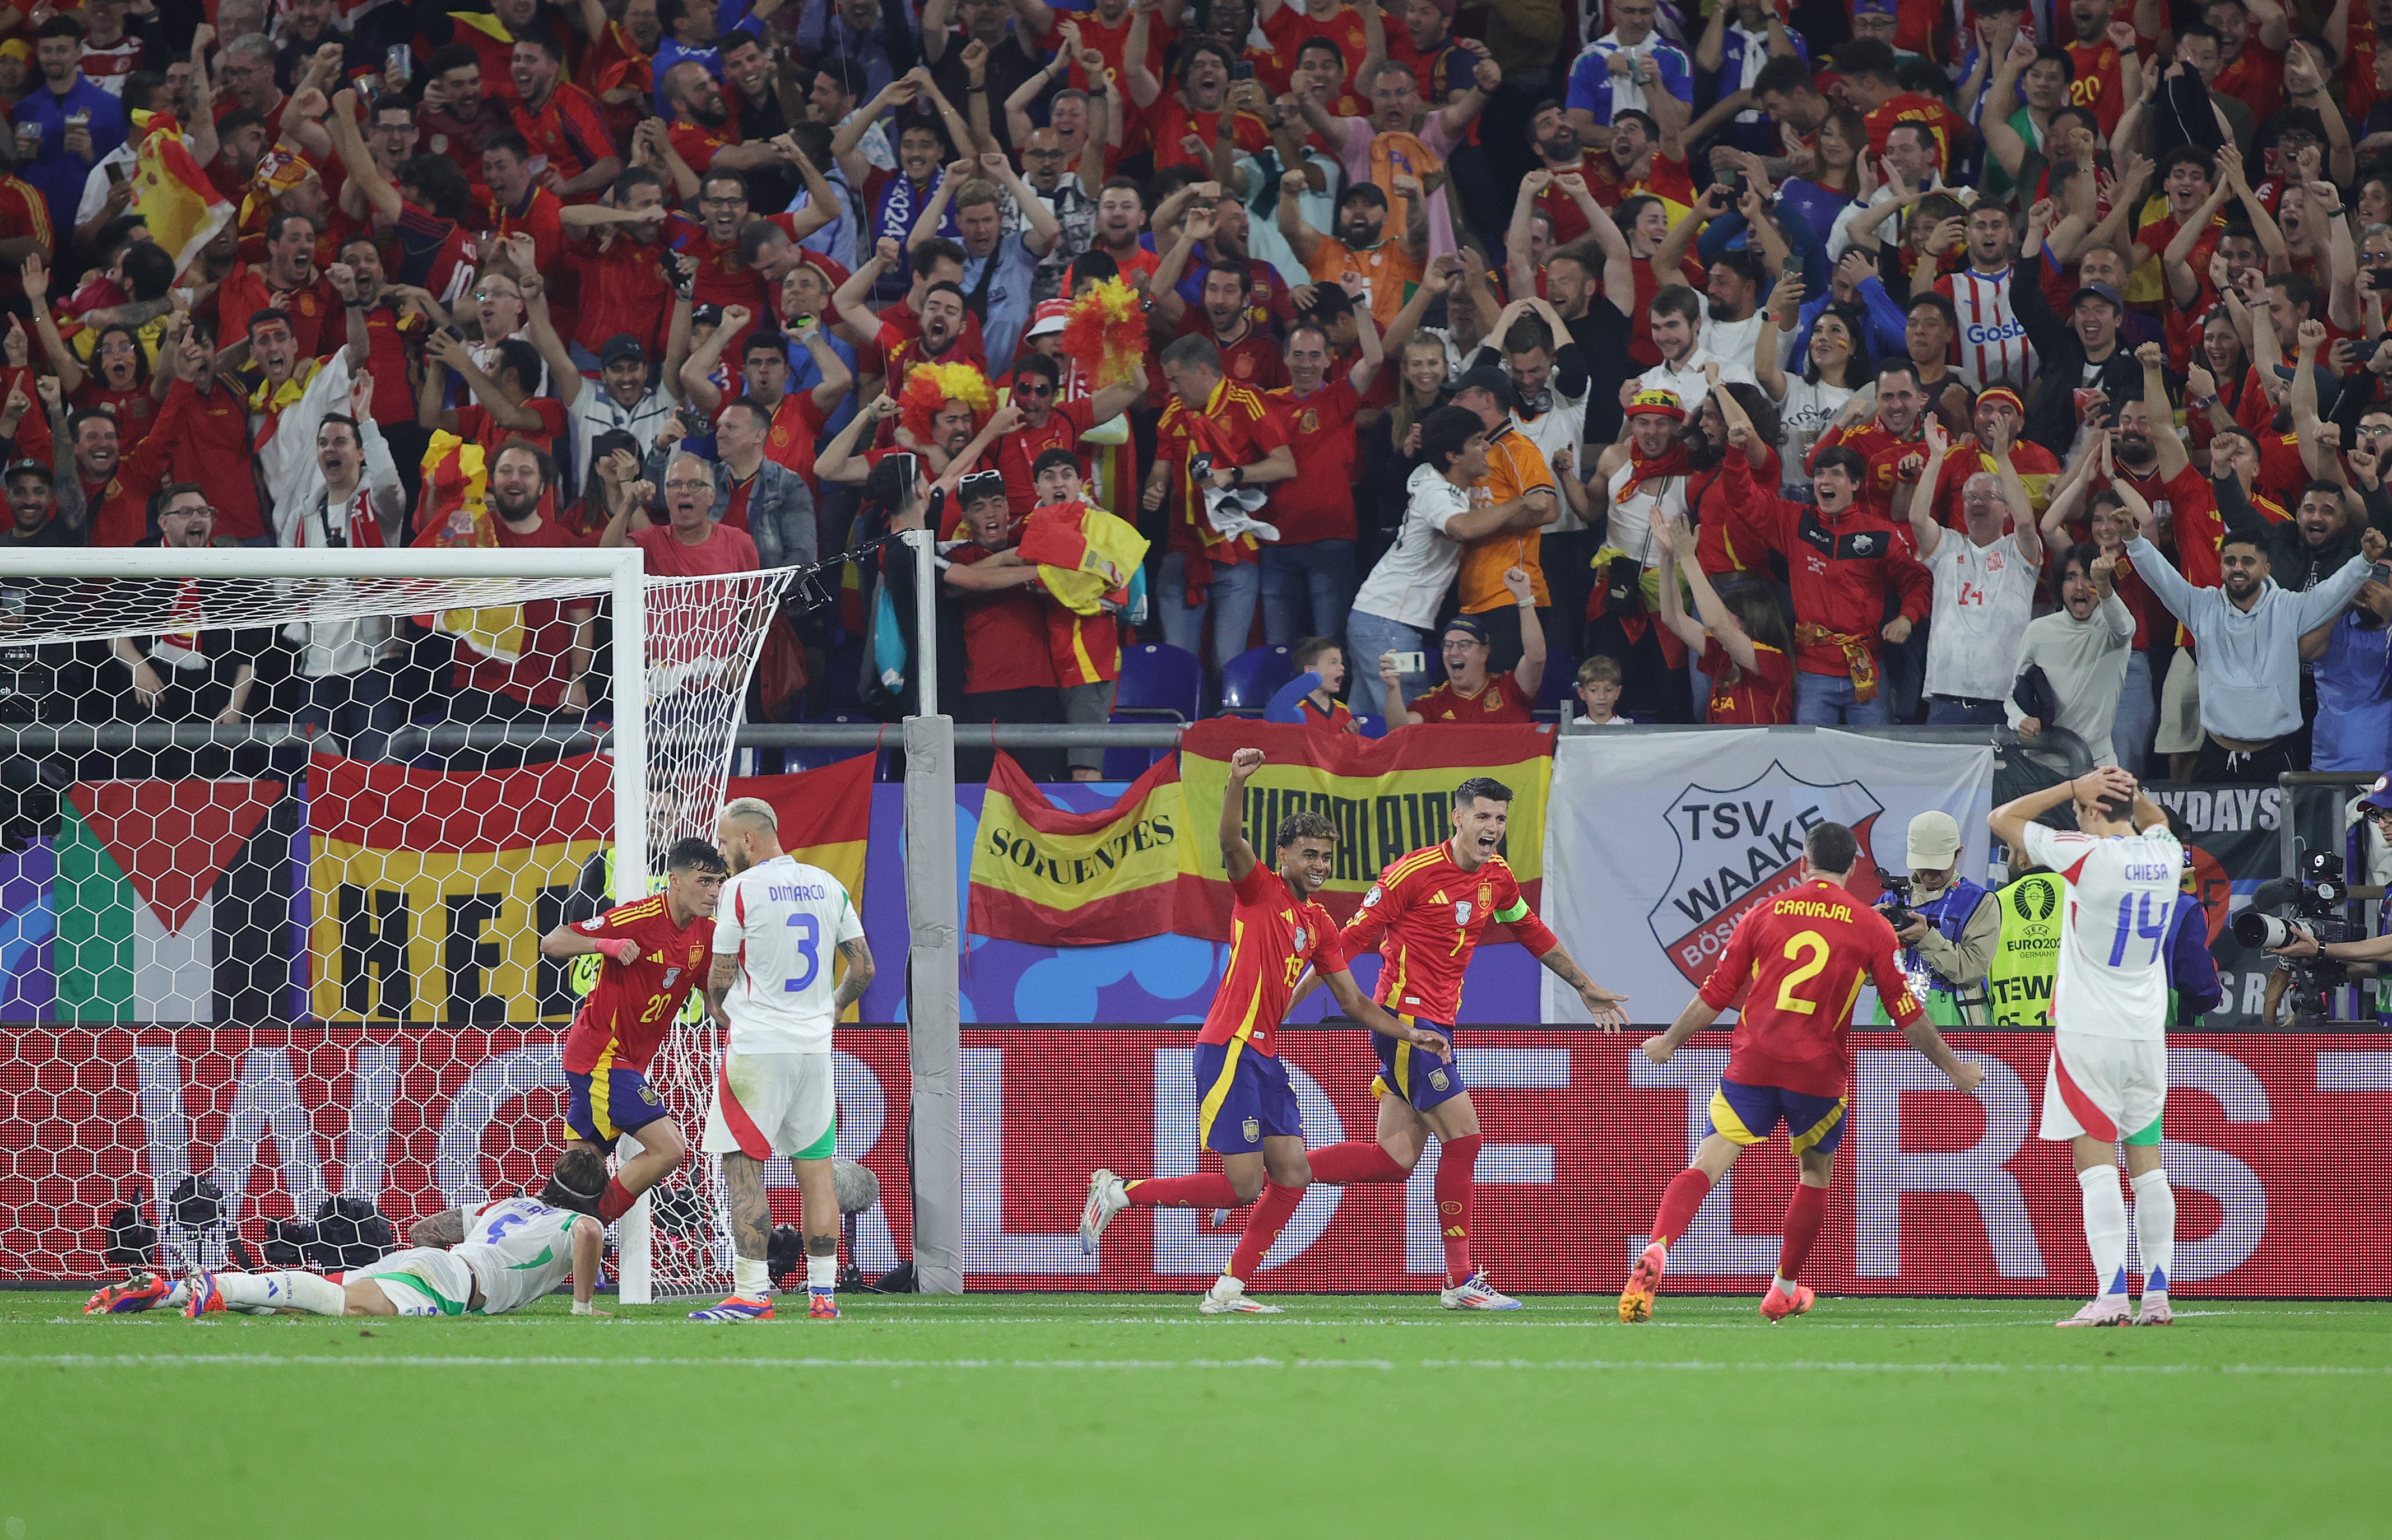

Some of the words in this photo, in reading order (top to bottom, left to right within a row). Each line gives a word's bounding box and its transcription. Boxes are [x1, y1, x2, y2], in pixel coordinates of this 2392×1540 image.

[2070, 75, 2100, 106] 20
[1682, 799, 1774, 841] TSV
[1673, 805, 1826, 924] WAAKE
[2124, 863, 2169, 881] CHIESA
[769, 884, 825, 902] DIMARCO
[1774, 900, 1854, 924] CARVAJAL
[1449, 928, 1466, 957] 7
[2025, 928, 2049, 936] UEFA
[2108, 891, 2169, 967] 14
[784, 913, 820, 992] 3
[2019, 950, 2056, 959] GERMANY
[1283, 953, 1304, 988] 19
[1775, 929, 1831, 1016] 2
[1991, 975, 2054, 1007] TEW
[639, 992, 672, 1023] 20
